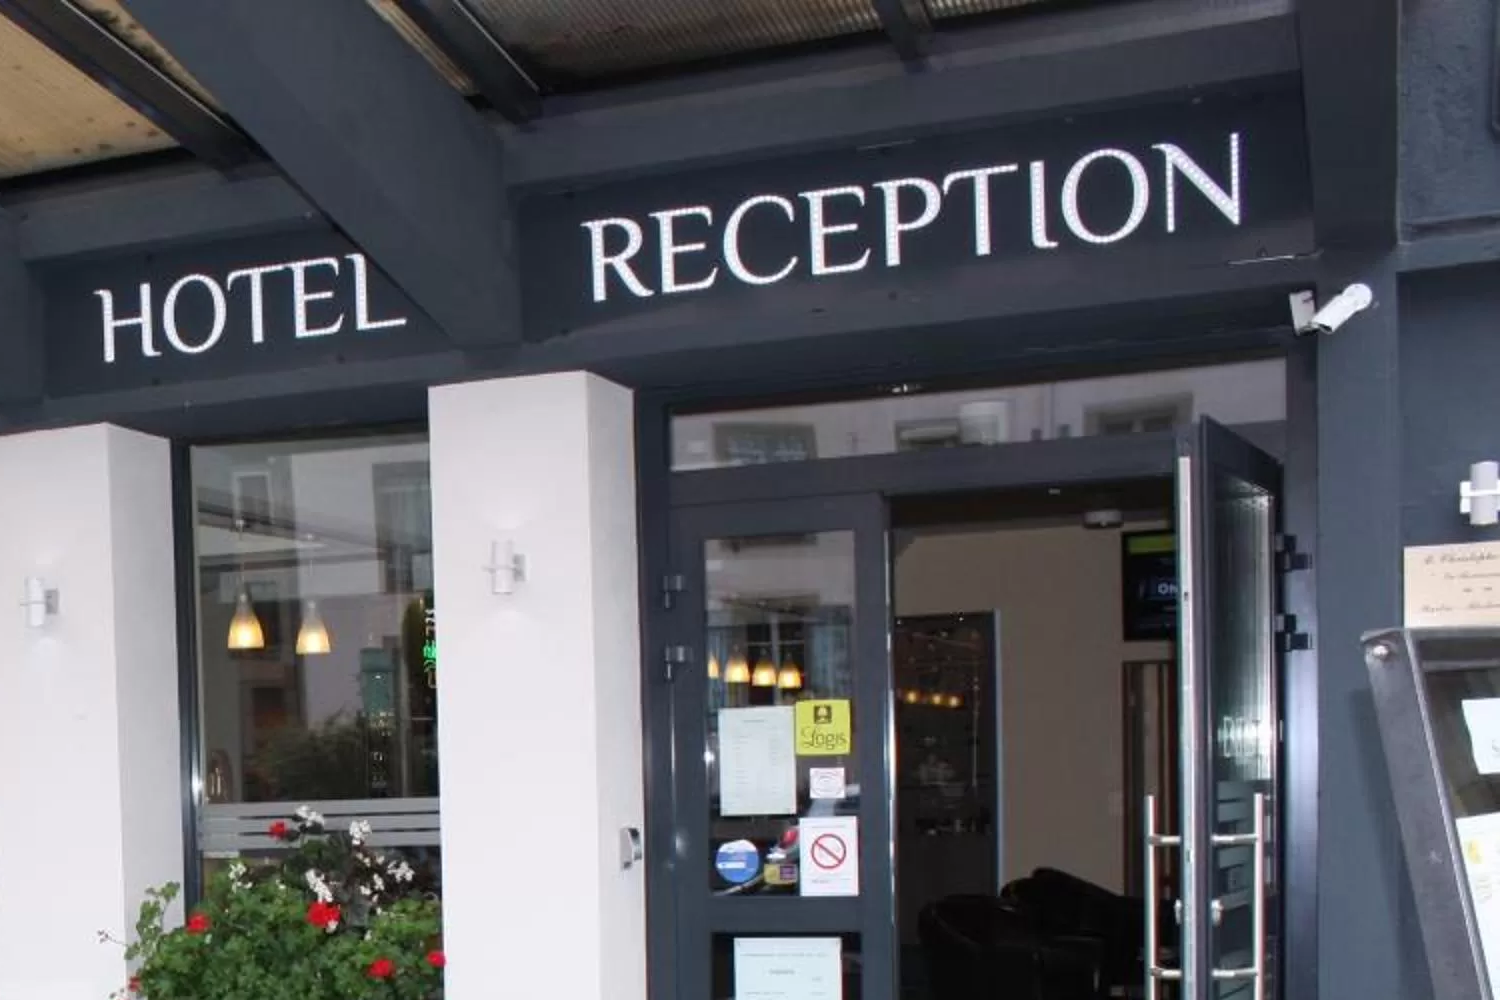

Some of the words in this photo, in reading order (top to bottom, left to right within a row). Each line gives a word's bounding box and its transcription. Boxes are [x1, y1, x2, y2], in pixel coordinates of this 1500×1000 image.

[580, 132, 1241, 303] RECEPTION
[93, 252, 408, 363] HOTEL
[801, 725, 847, 750] Logis
